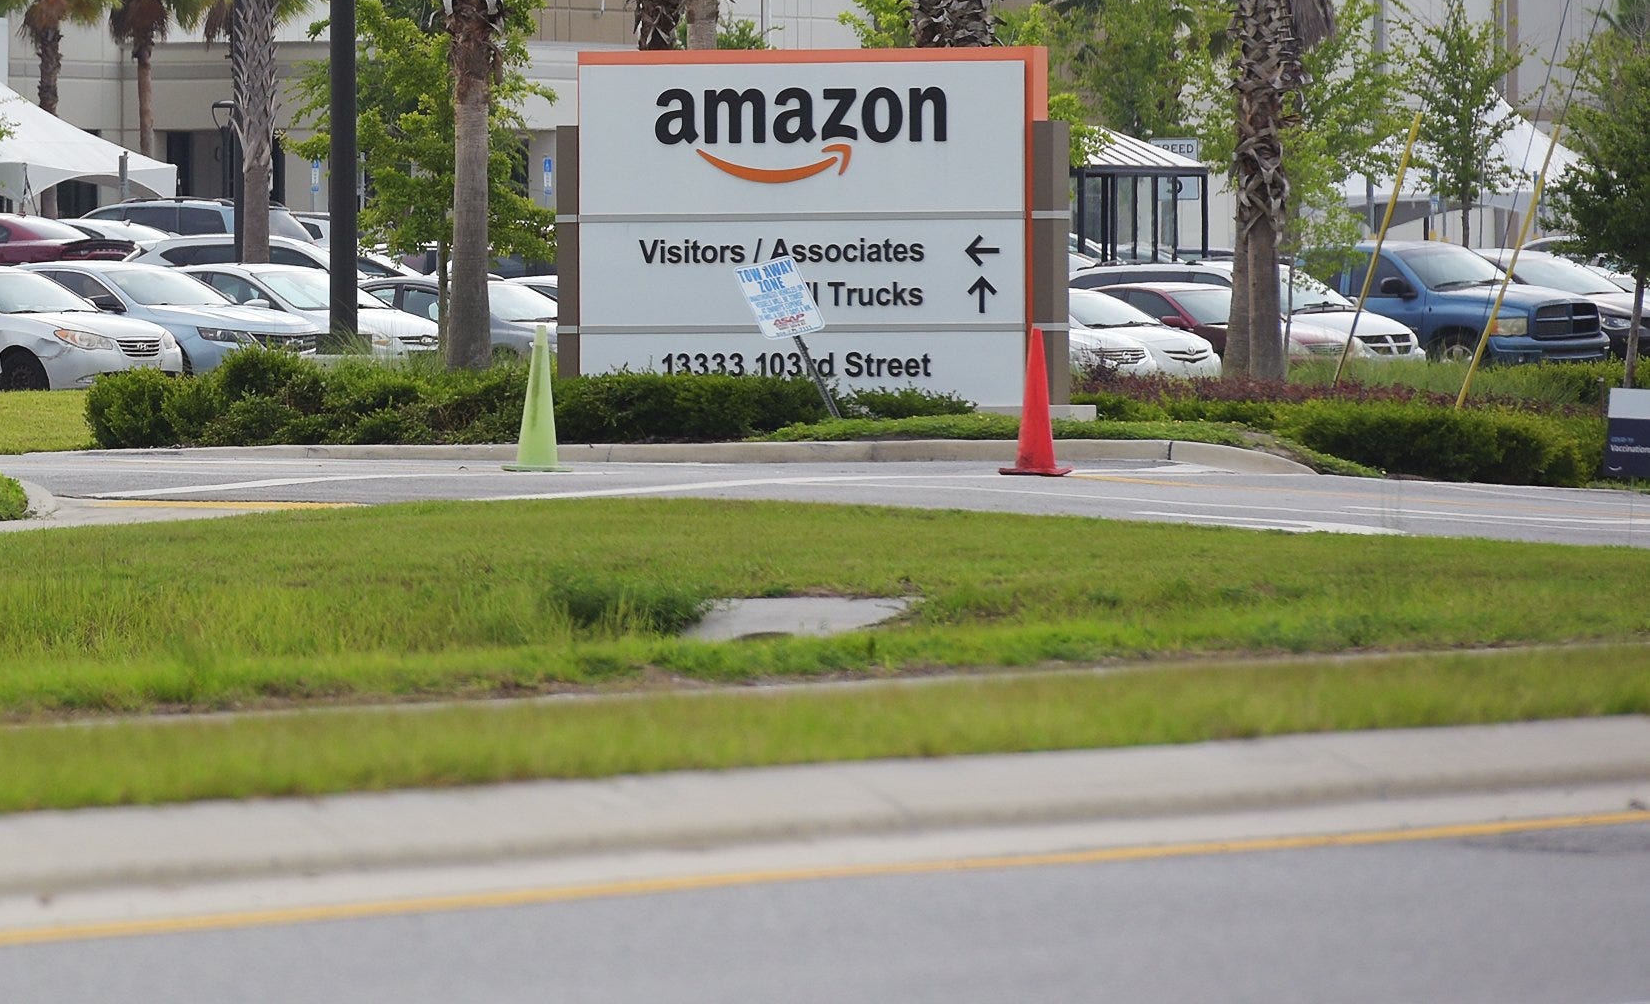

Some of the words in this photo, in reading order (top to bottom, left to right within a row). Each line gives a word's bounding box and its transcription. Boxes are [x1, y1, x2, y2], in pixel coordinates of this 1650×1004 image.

[654, 86, 947, 145] amazon
[1154, 143, 1194, 154] PEED
[638, 239, 746, 264] Visitors
[753, 238, 762, 263] /
[770, 238, 925, 263] Associates
[737, 268, 763, 283] TOW
[762, 260, 793, 278] AWAY
[758, 277, 785, 293] ZONE
[827, 282, 924, 307] Trucks
[662, 352, 745, 377] 13333
[844, 351, 932, 378] Street
